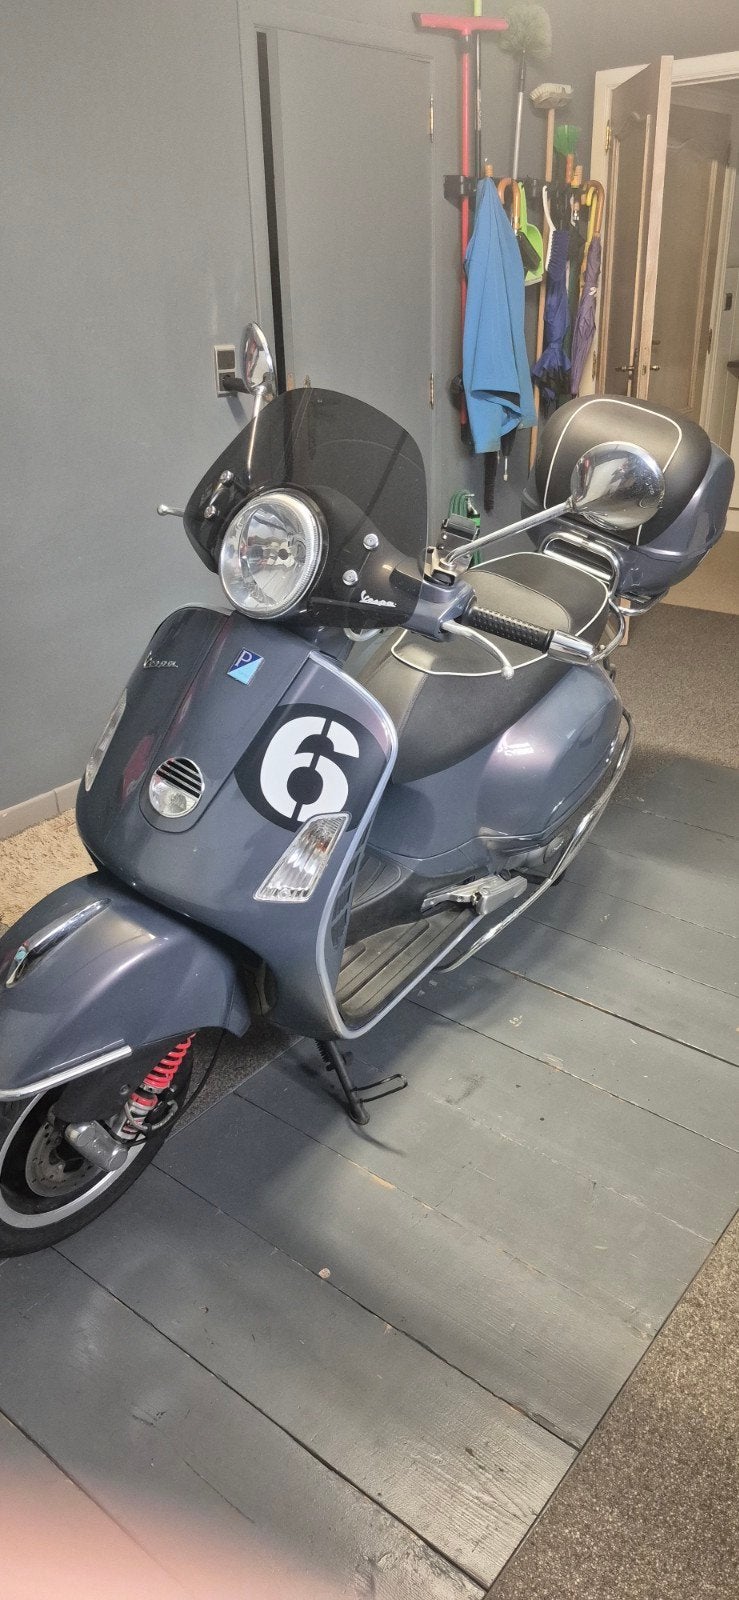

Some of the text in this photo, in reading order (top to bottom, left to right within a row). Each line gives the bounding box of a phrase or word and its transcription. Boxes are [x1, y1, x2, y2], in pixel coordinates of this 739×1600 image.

[359, 590, 397, 608] Vespa
[143, 650, 179, 669] Vespa
[234, 650, 253, 667] P
[260, 716, 360, 822] 6
